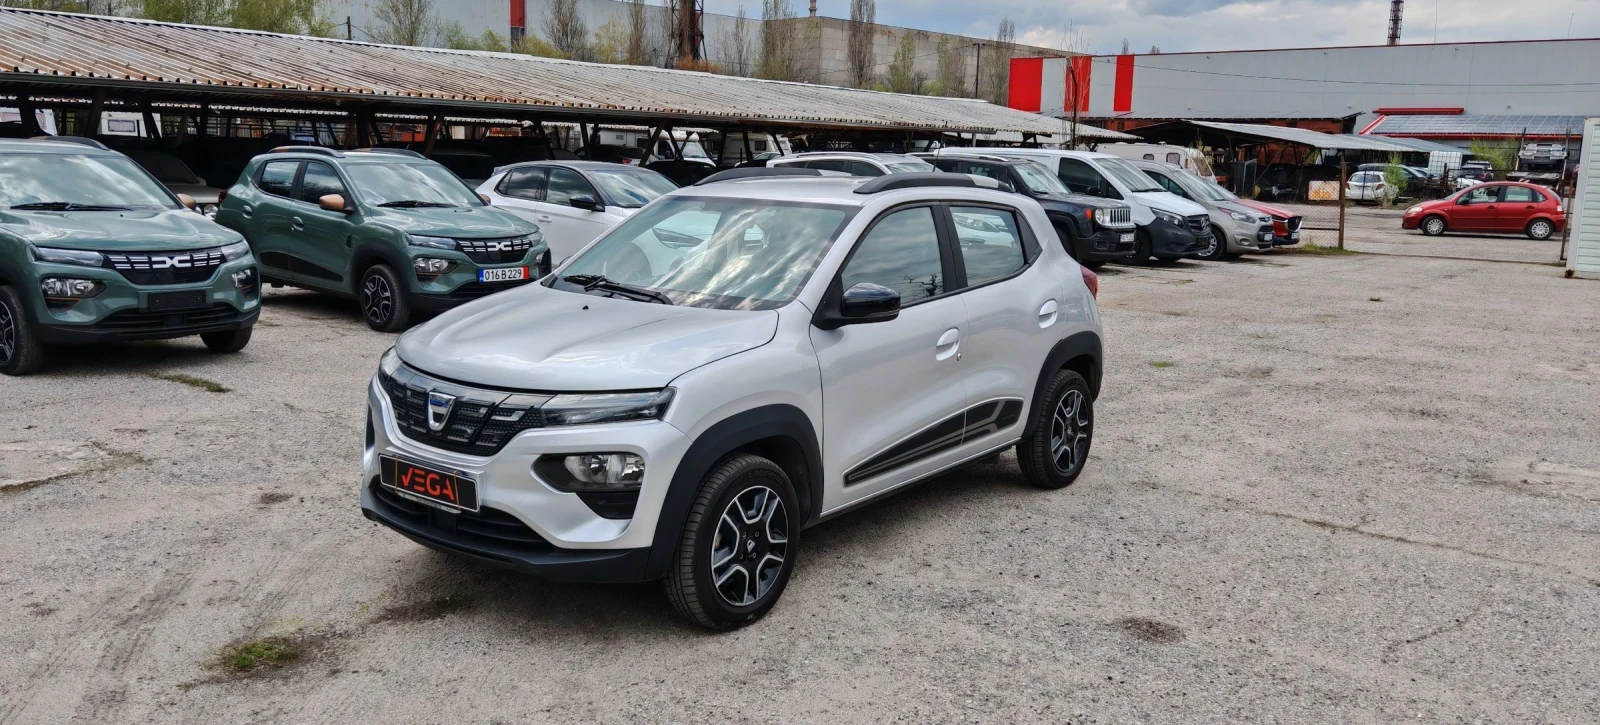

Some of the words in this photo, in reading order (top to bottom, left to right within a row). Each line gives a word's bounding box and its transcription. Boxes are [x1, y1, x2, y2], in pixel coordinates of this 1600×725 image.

[485, 270, 500, 280] 016
[501, 270, 507, 279] B
[508, 269, 522, 279] 229
[401, 467, 455, 500] VEGA
